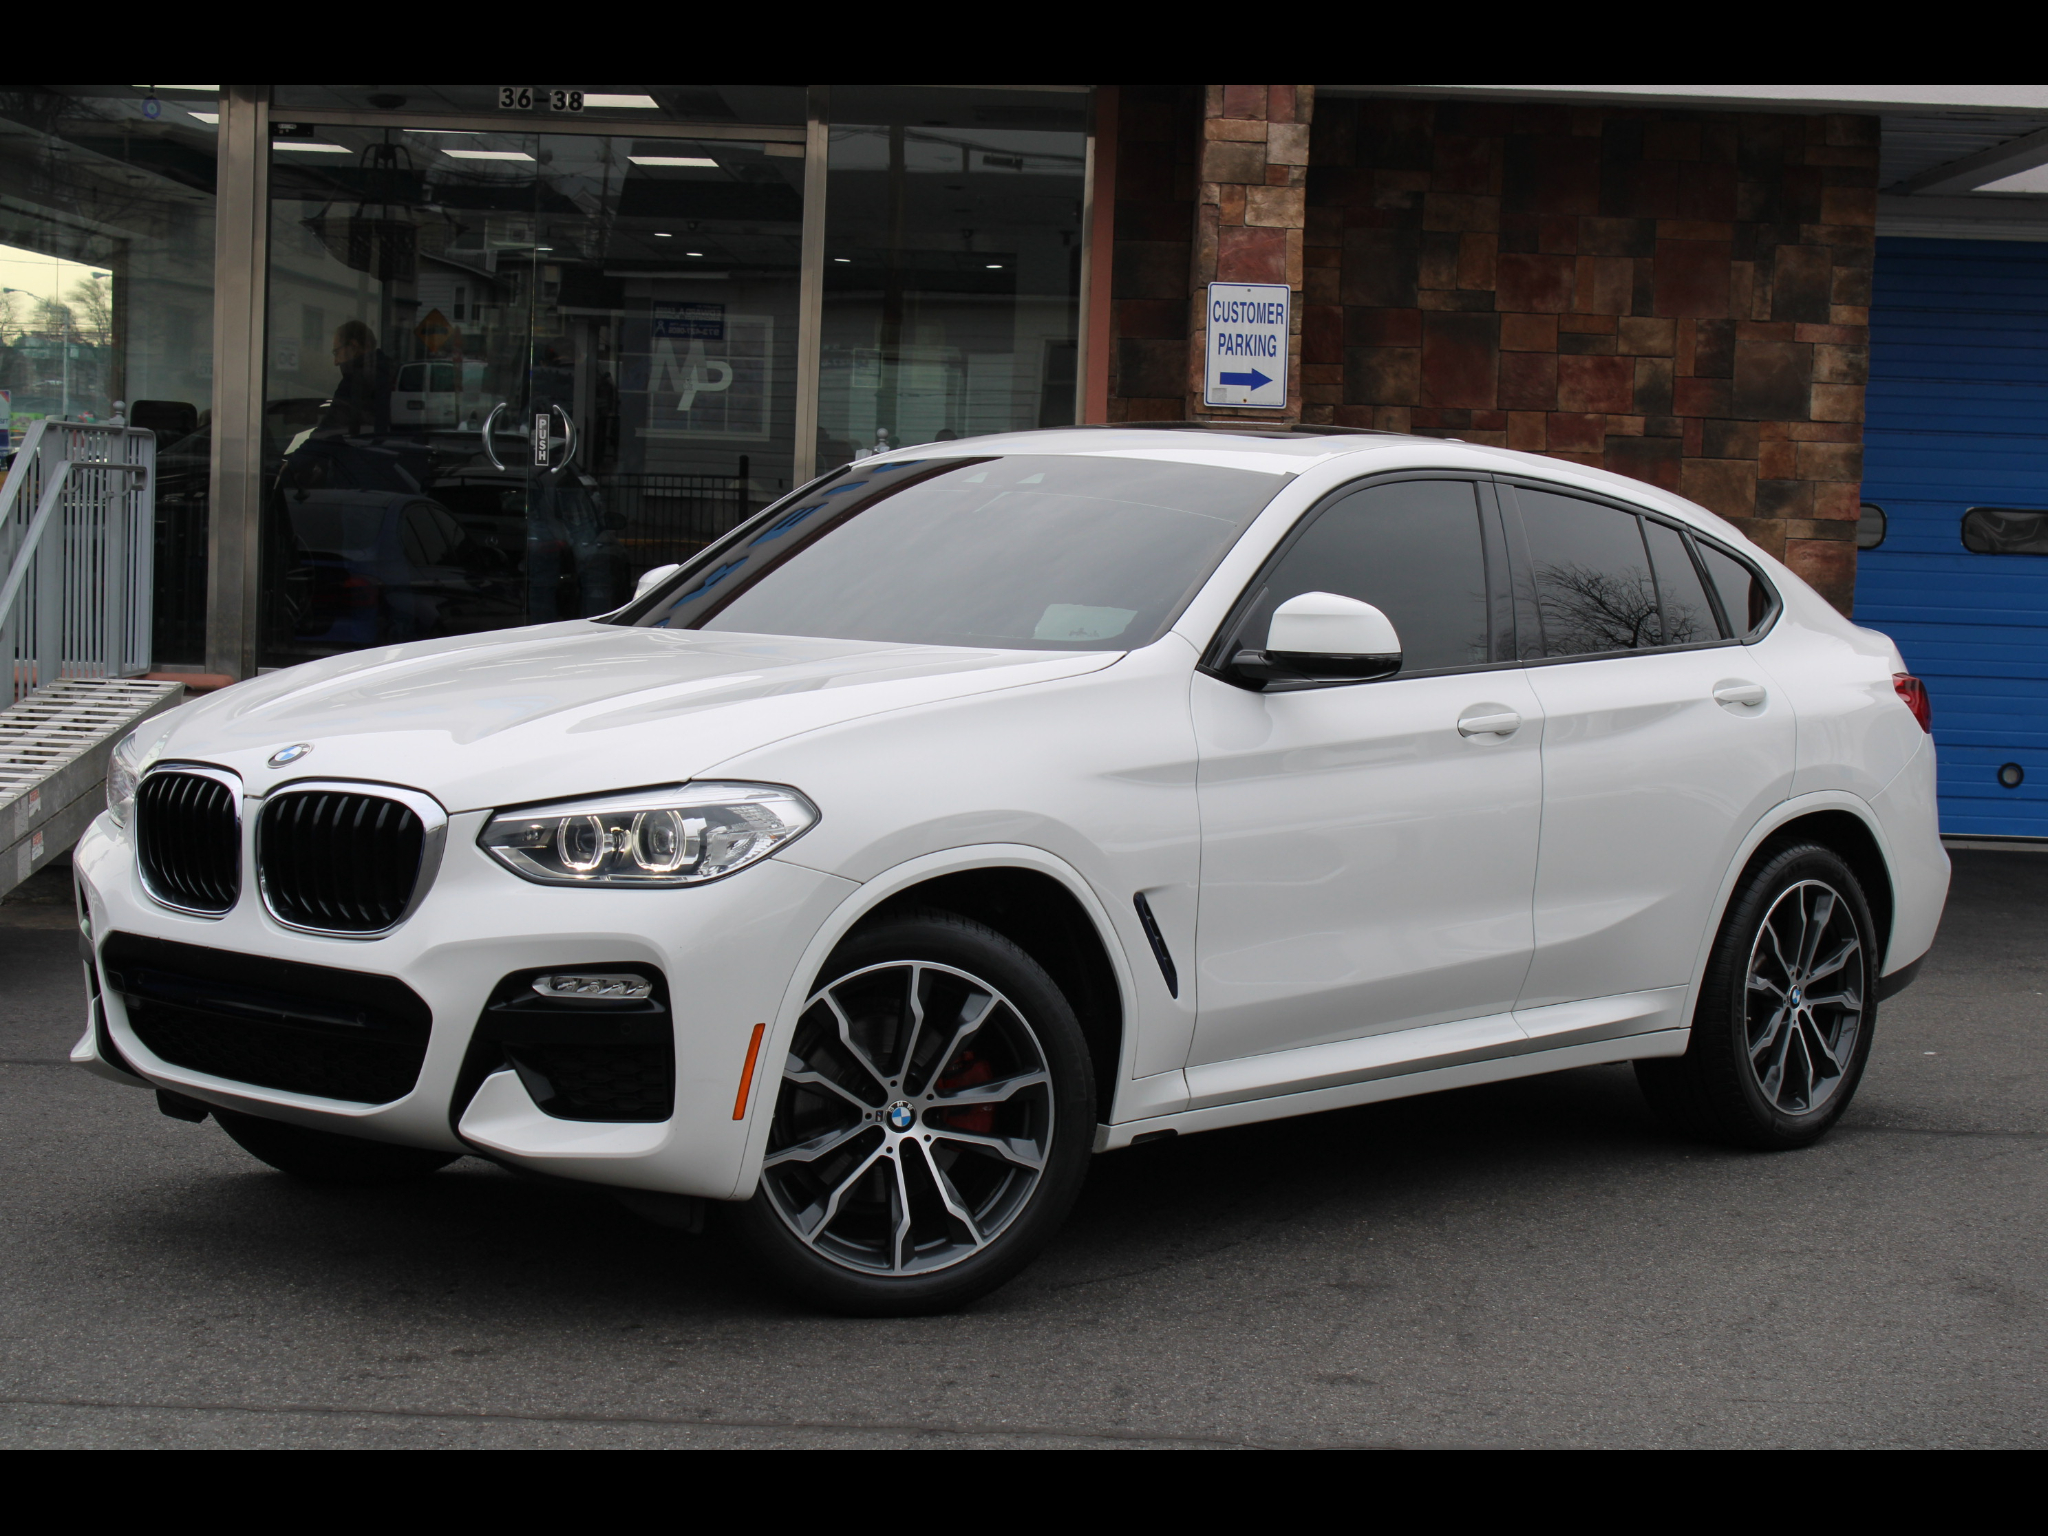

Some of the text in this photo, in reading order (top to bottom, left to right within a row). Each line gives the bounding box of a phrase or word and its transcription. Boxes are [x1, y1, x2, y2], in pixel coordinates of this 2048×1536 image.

[501, 87, 583, 111] 36-38
[1212, 300, 1284, 325] CUSTOMER
[1217, 332, 1277, 358] PARKING
[538, 419, 547, 461] PUSH
